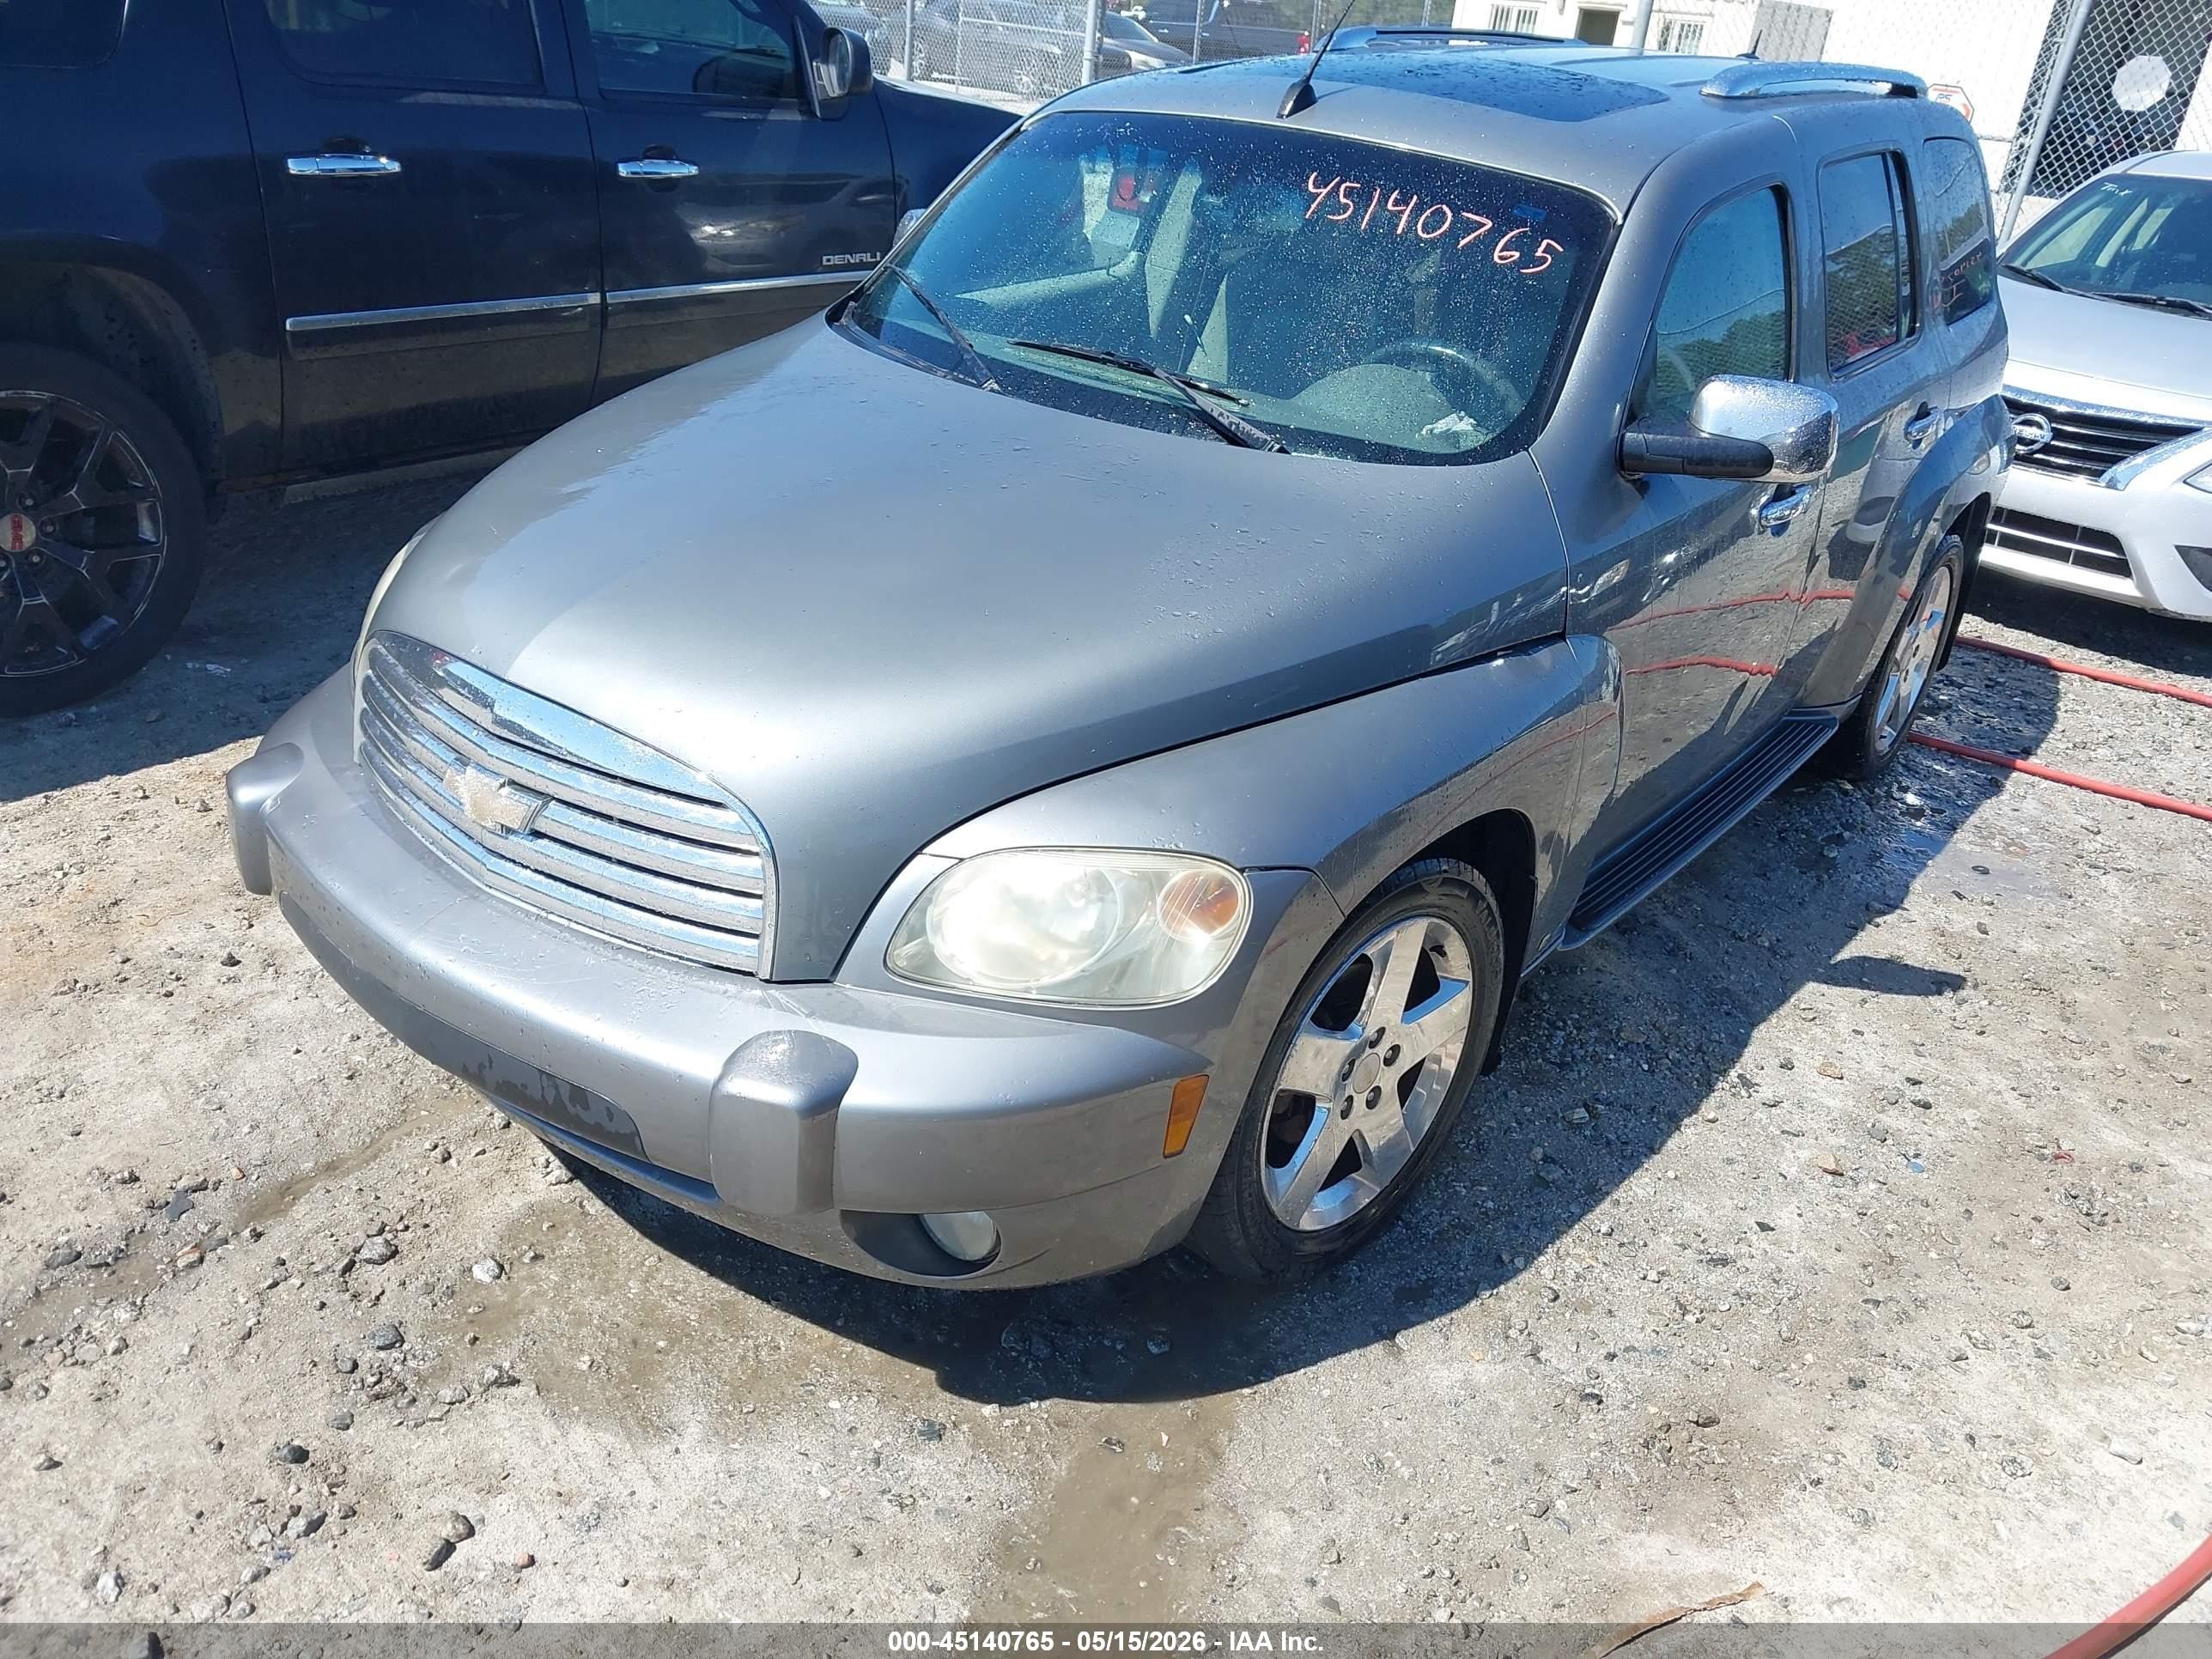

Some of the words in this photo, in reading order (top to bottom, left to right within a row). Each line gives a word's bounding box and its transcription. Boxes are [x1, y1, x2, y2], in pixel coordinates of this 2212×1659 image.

[1305, 171, 1564, 274] 45140765
[822, 252, 881, 265] DENALI
[11, 514, 23, 550] GMC
